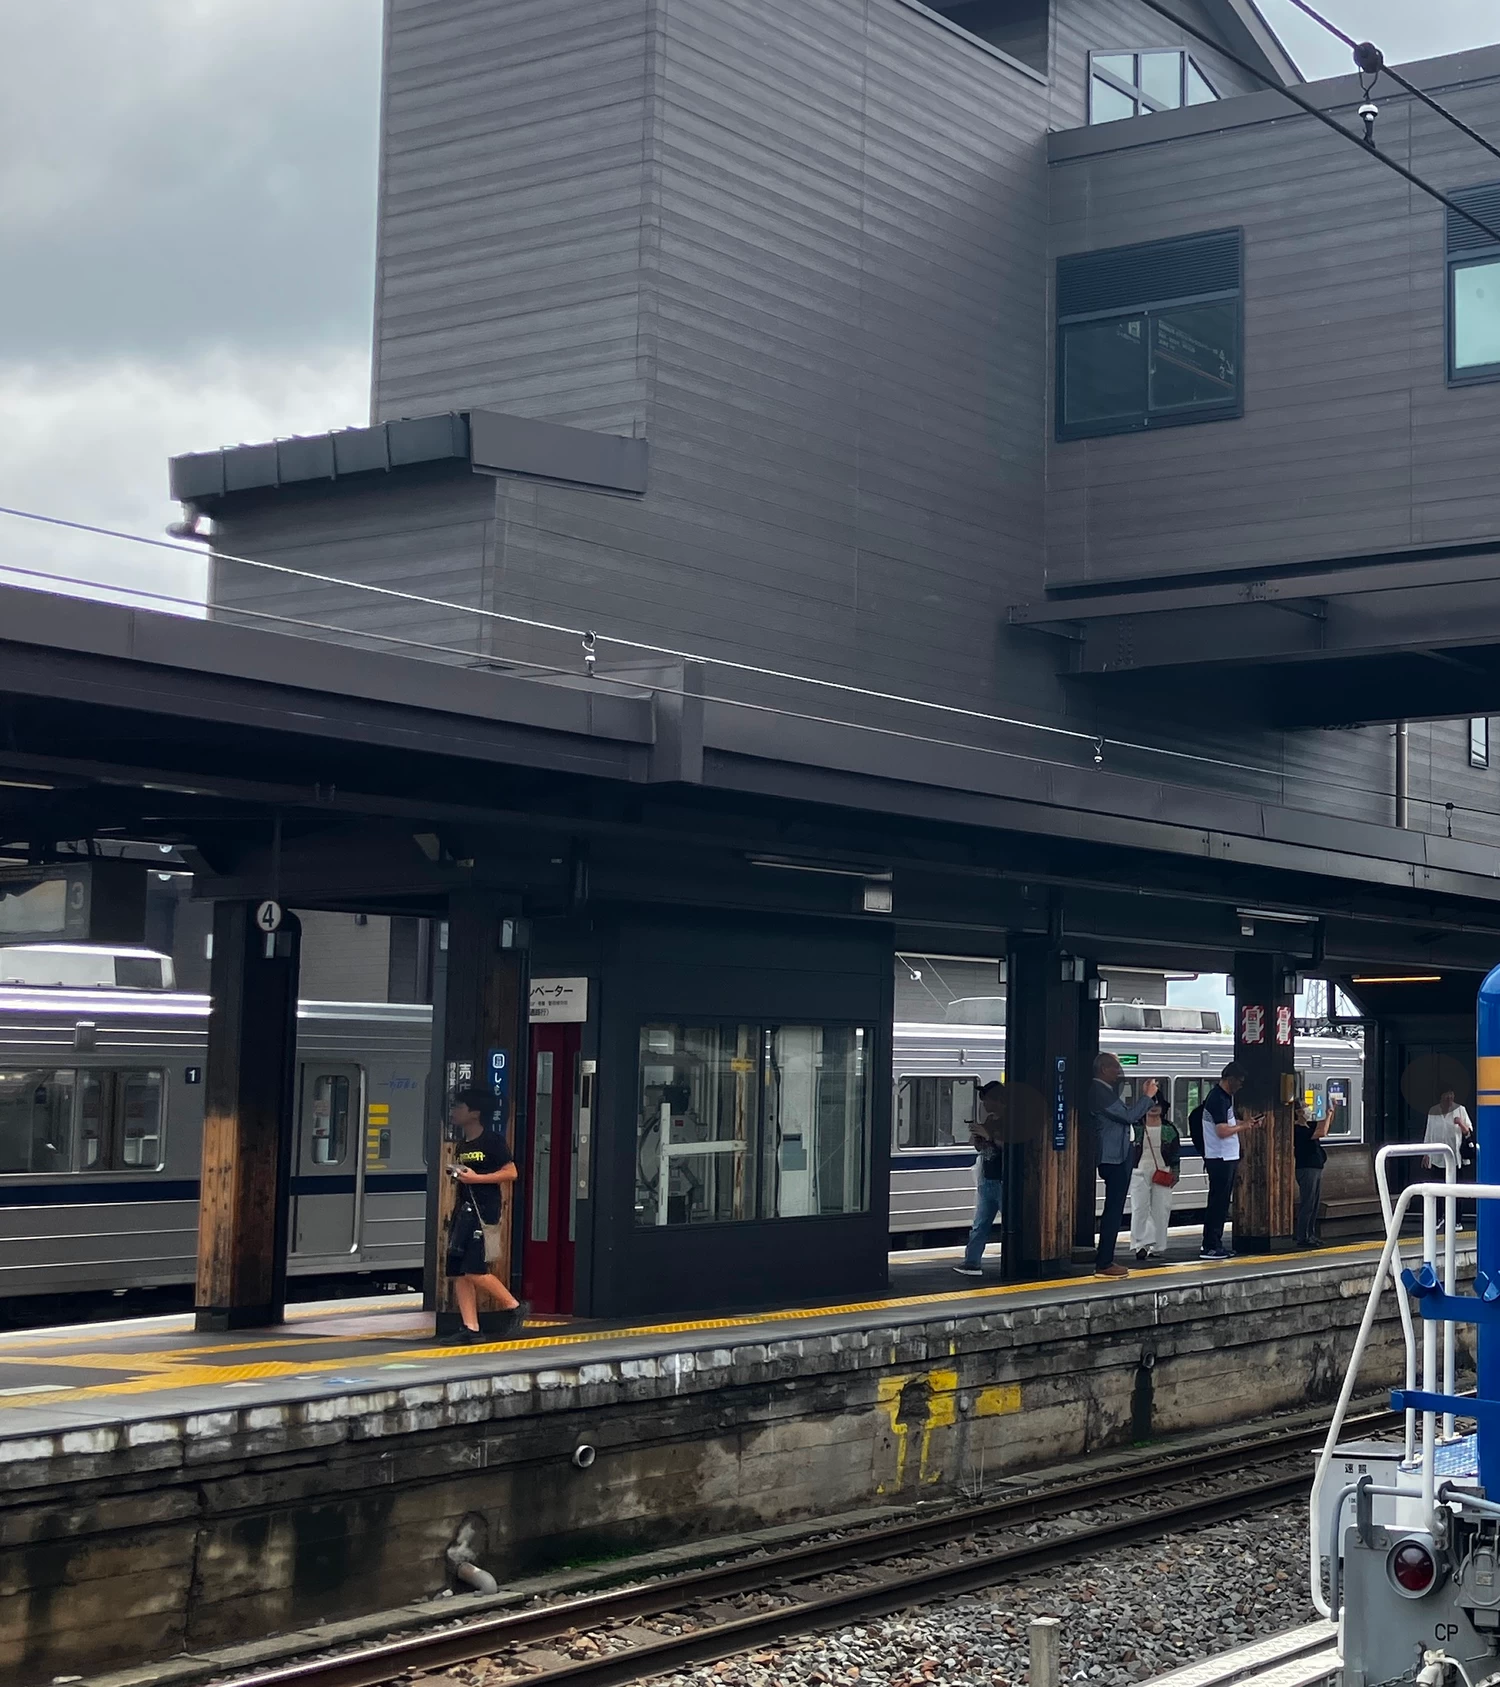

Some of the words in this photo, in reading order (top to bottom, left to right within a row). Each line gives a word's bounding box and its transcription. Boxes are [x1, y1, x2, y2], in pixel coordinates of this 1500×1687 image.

[262, 903, 275, 928] 4
[188, 1069, 197, 1083] 1
[1434, 1623, 1459, 1642] CP
